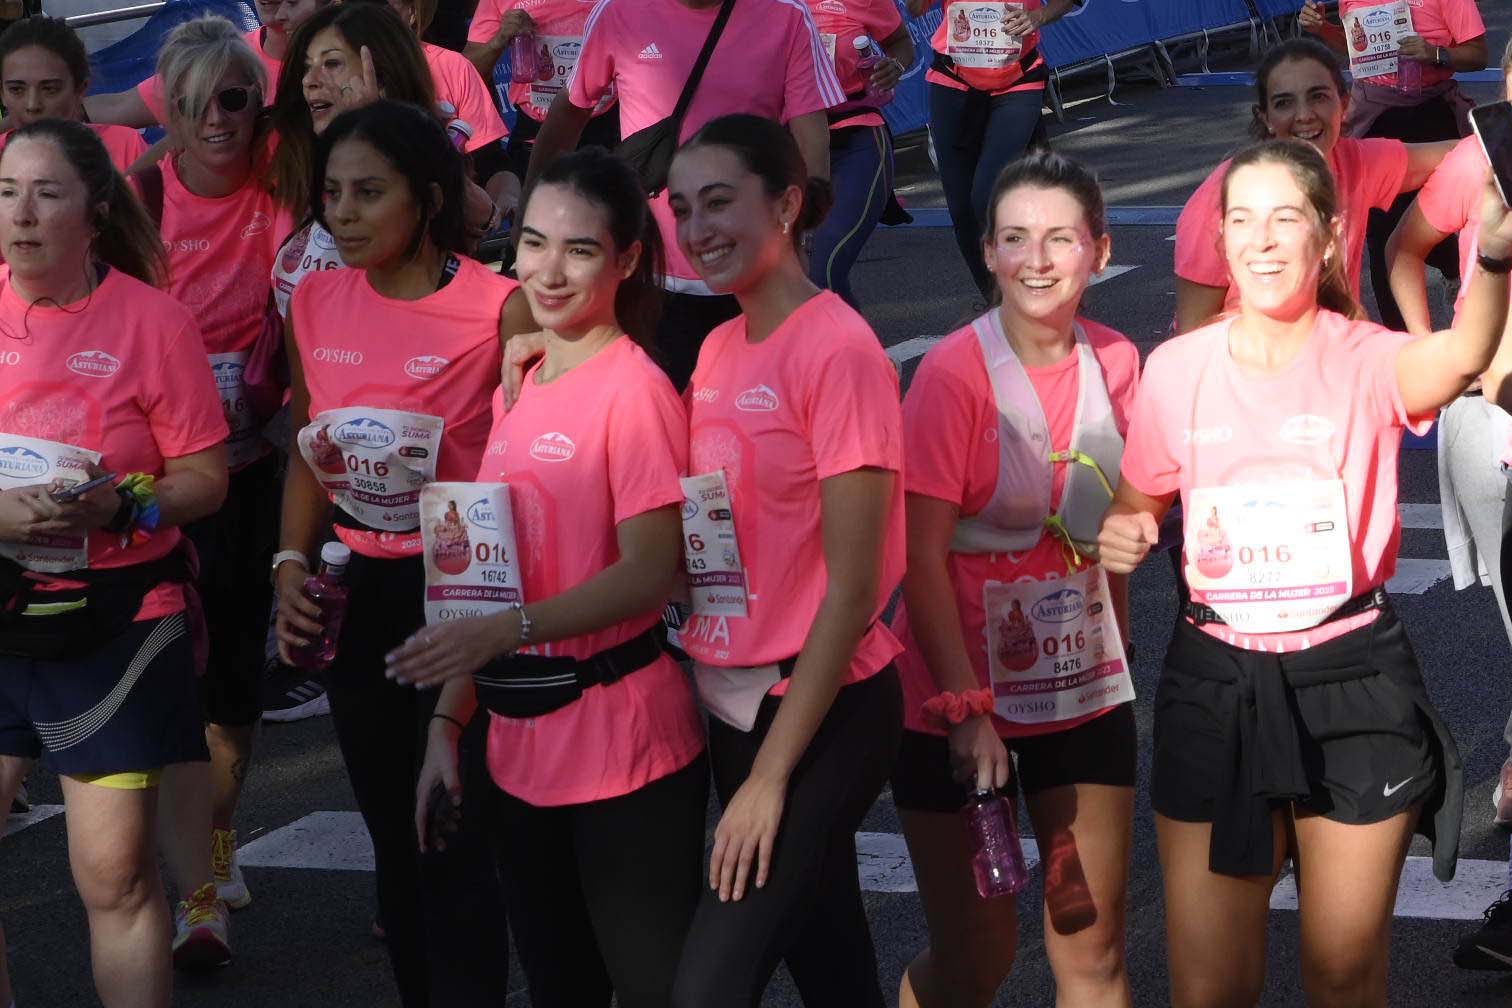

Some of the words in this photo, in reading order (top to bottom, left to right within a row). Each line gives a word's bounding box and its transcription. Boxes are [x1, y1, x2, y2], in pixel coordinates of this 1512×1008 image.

[973, 28, 997, 38] 016
[1369, 30, 1391, 44] 016
[557, 48, 579, 56] ASTURI
[165, 239, 210, 253] OSHO
[313, 347, 364, 366] OYSHO
[222, 399, 244, 411] 16
[401, 430, 432, 440] SUMA
[347, 454, 390, 478] 016
[354, 477, 388, 493] 30858
[361, 493, 371, 503] DE
[371, 495, 380, 504] LA
[381, 495, 410, 506] MUJER
[393, 512, 420, 523] Santa
[1239, 544, 1292, 565] 016
[442, 588, 482, 598] CARRERA
[1264, 590, 1277, 600] LA
[1043, 630, 1086, 657] 016
[1054, 658, 1082, 674] 8476
[1010, 680, 1053, 693] CARRERA
[1055, 679, 1066, 689] DE
[1067, 676, 1079, 687] LA
[1008, 701, 1056, 715] OYSHO
